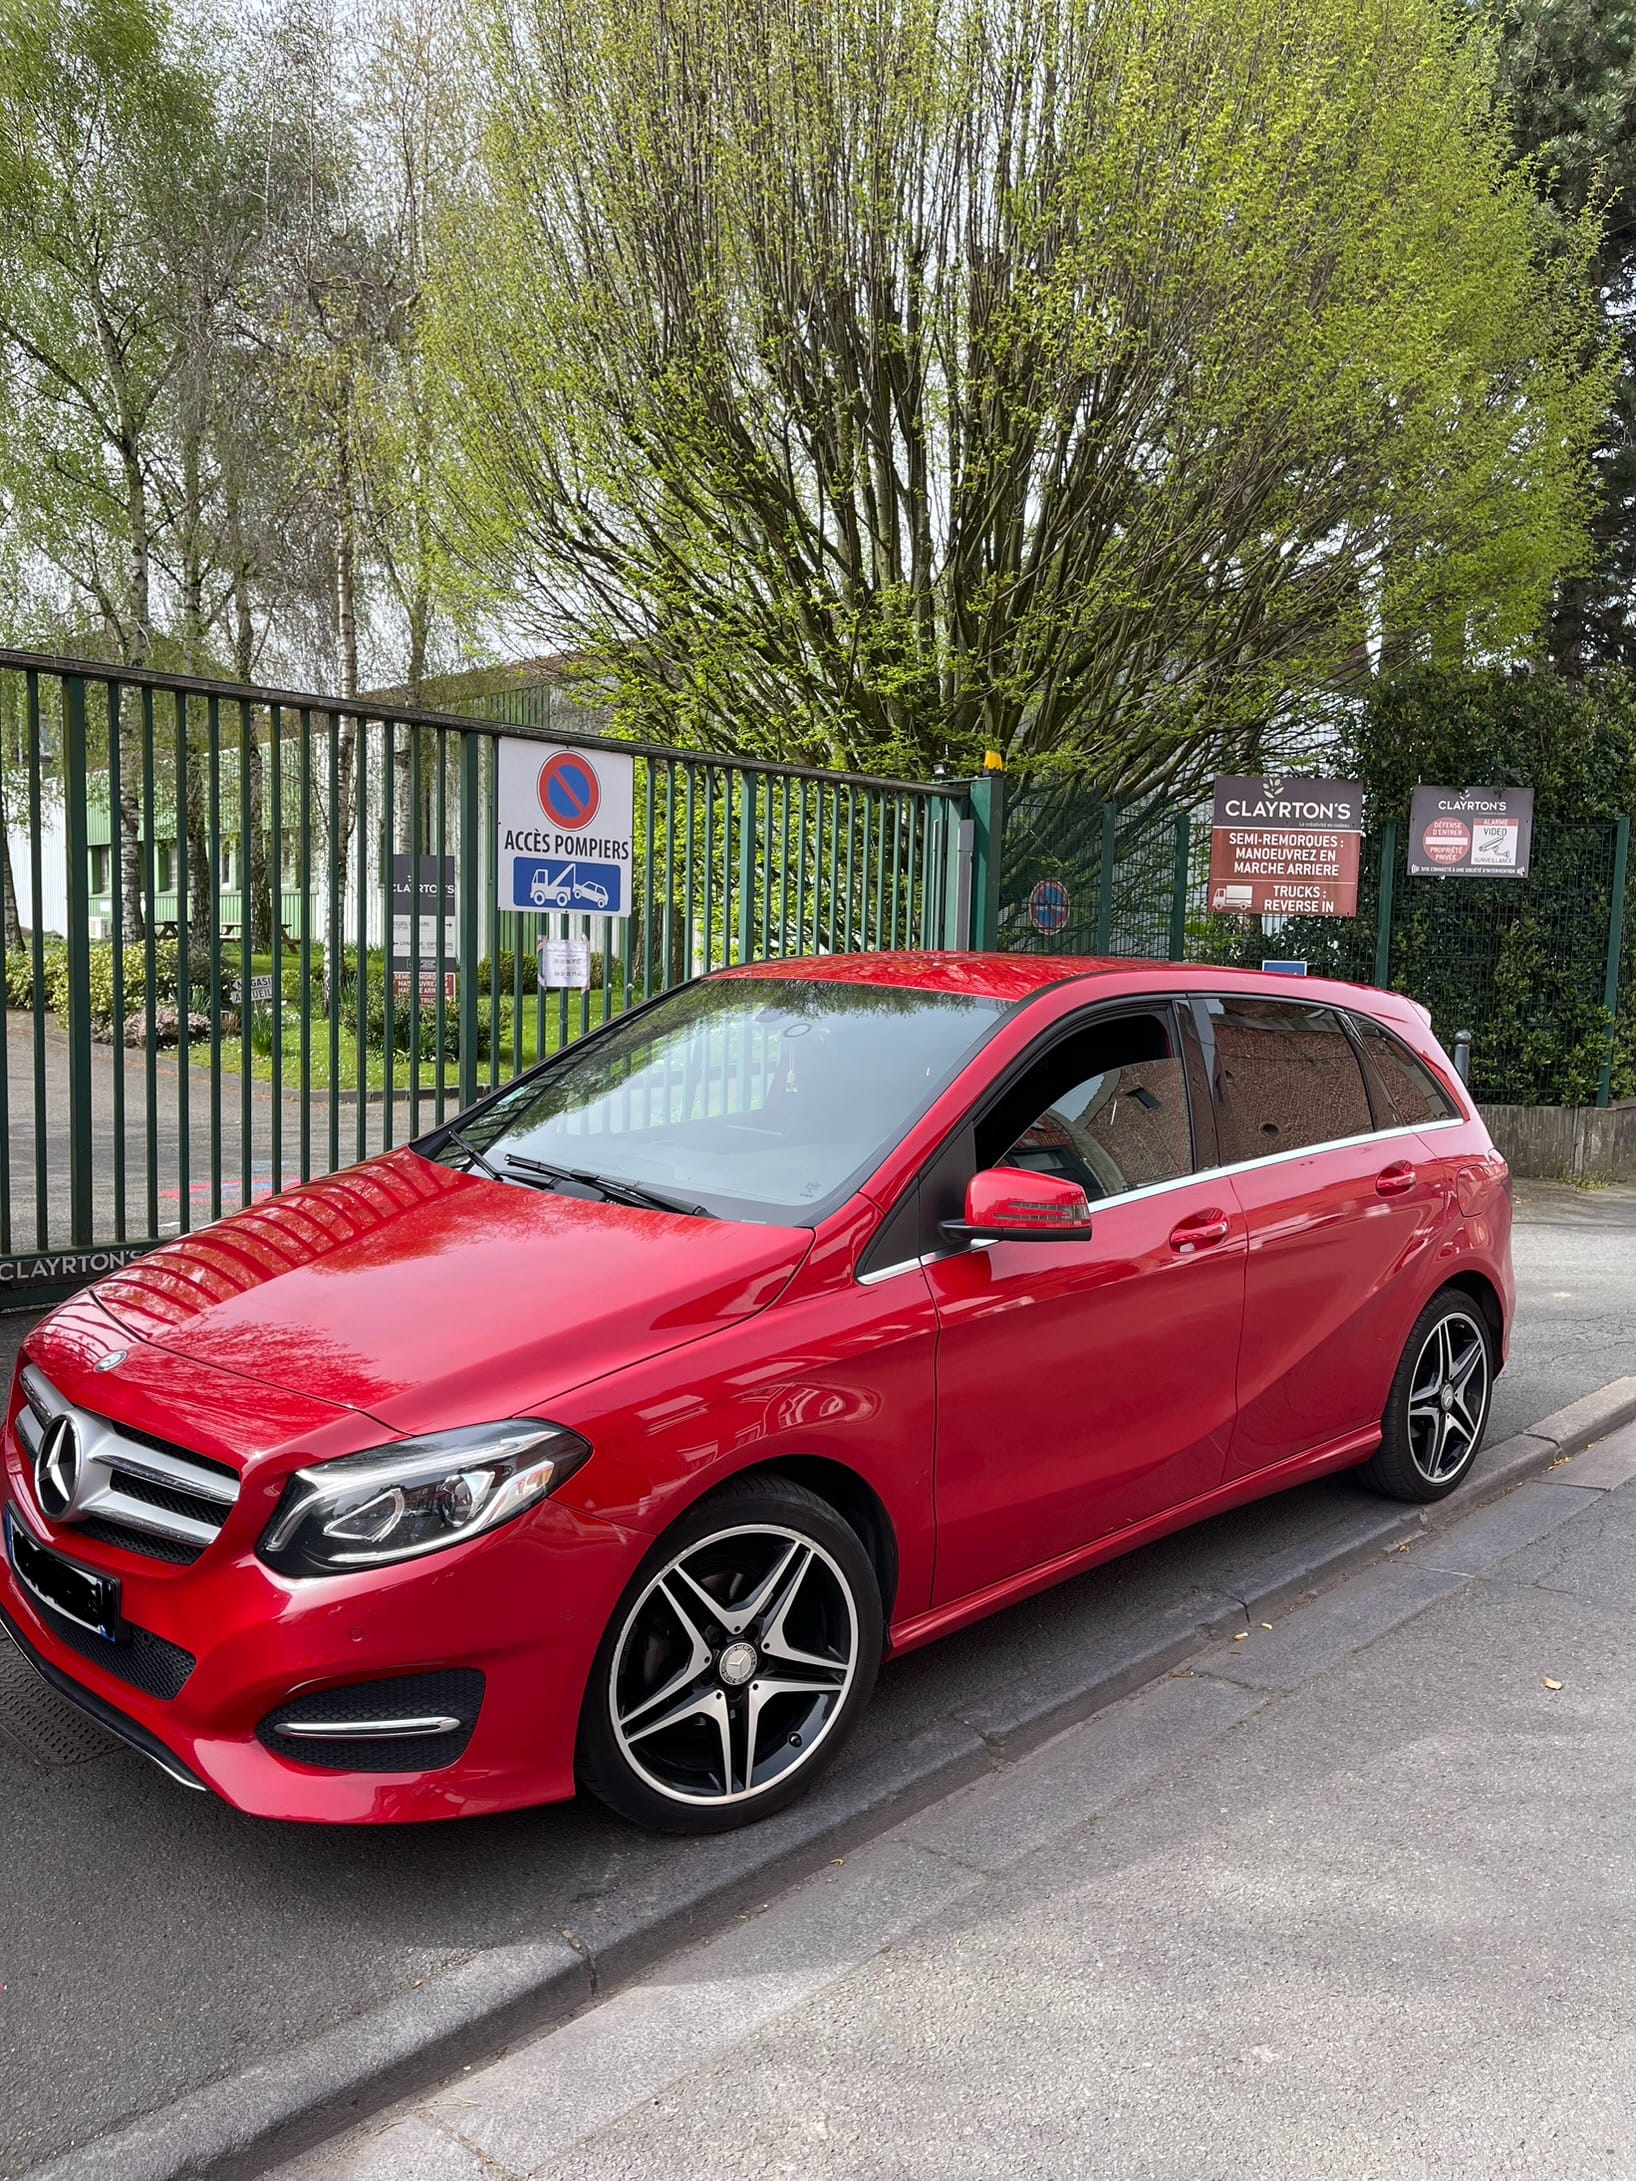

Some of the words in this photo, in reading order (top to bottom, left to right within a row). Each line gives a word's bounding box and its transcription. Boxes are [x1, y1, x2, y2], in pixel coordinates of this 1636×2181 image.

[1225, 800, 1351, 820] CLAYRTON'S
[1438, 800, 1507, 812] CLAYRTON'S
[504, 828, 550, 853] ACCÈS
[554, 834, 629, 860] POMPIERS
[1229, 832, 1338, 847] SEMI-REMORQUES
[1235, 847, 1317, 861] MANOEUVREZ
[1320, 850, 1336, 862] EN
[1234, 862, 1284, 875] MARCHE
[1287, 863, 1339, 876] ARRIERE
[1273, 885, 1320, 898] TRUCKS
[1264, 900, 1318, 912] REVERSE
[1322, 901, 1334, 913] IN
